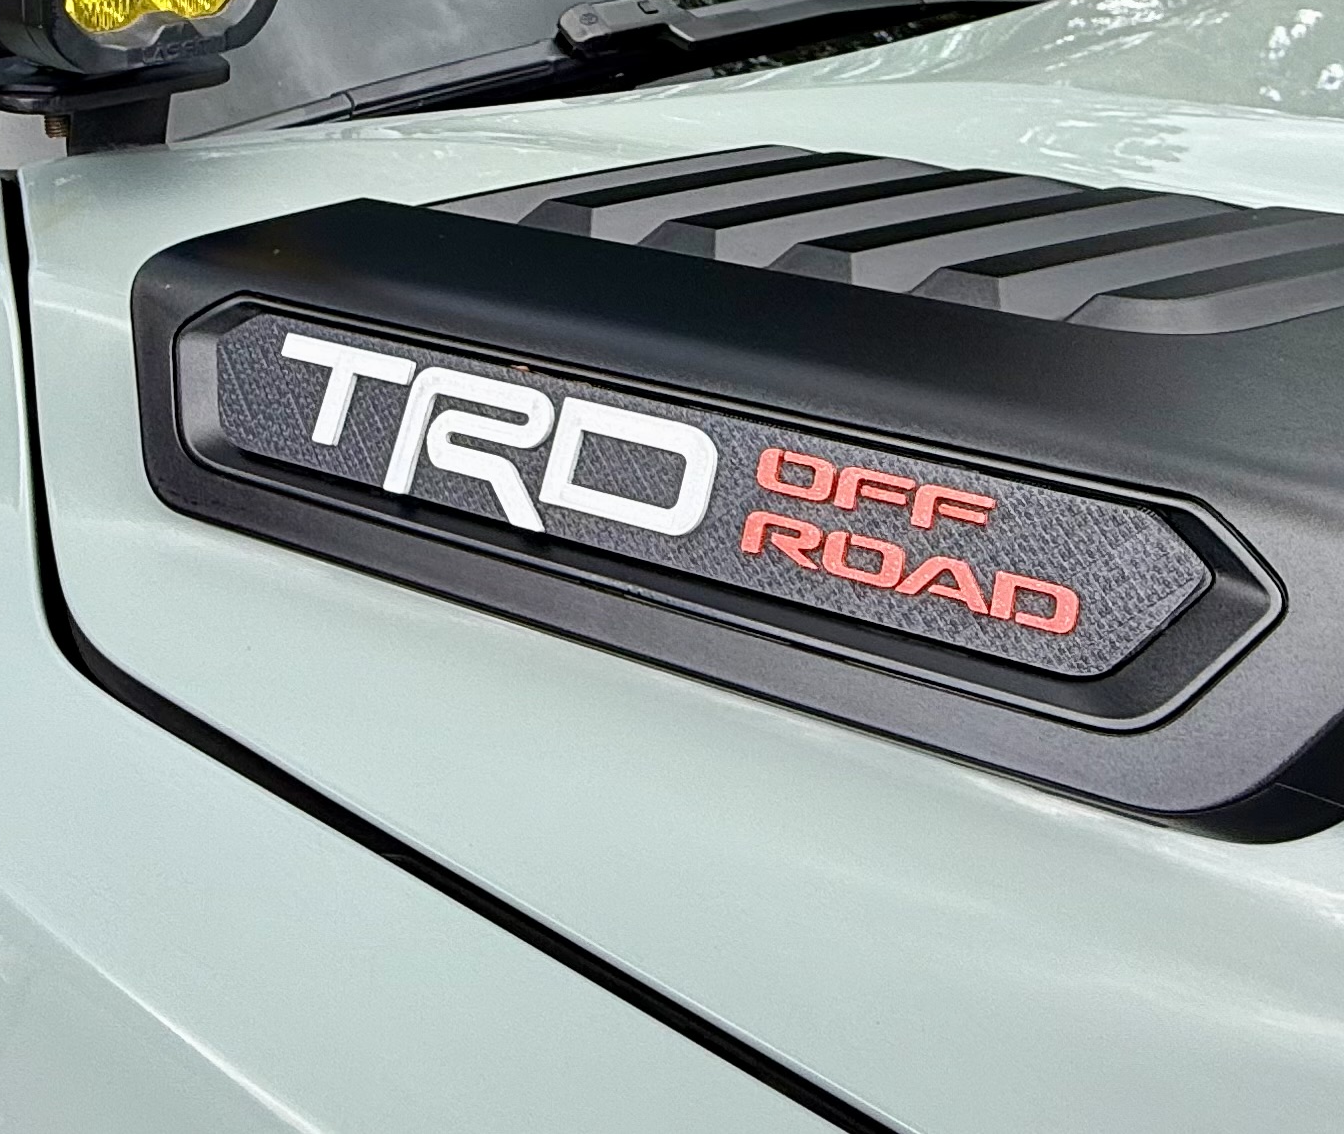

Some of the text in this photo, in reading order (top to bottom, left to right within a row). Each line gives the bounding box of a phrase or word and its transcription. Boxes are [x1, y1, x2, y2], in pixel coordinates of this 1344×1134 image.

[281, 332, 718, 535] TRD
[757, 448, 997, 529] OFF
[741, 510, 1081, 635] ROAD
